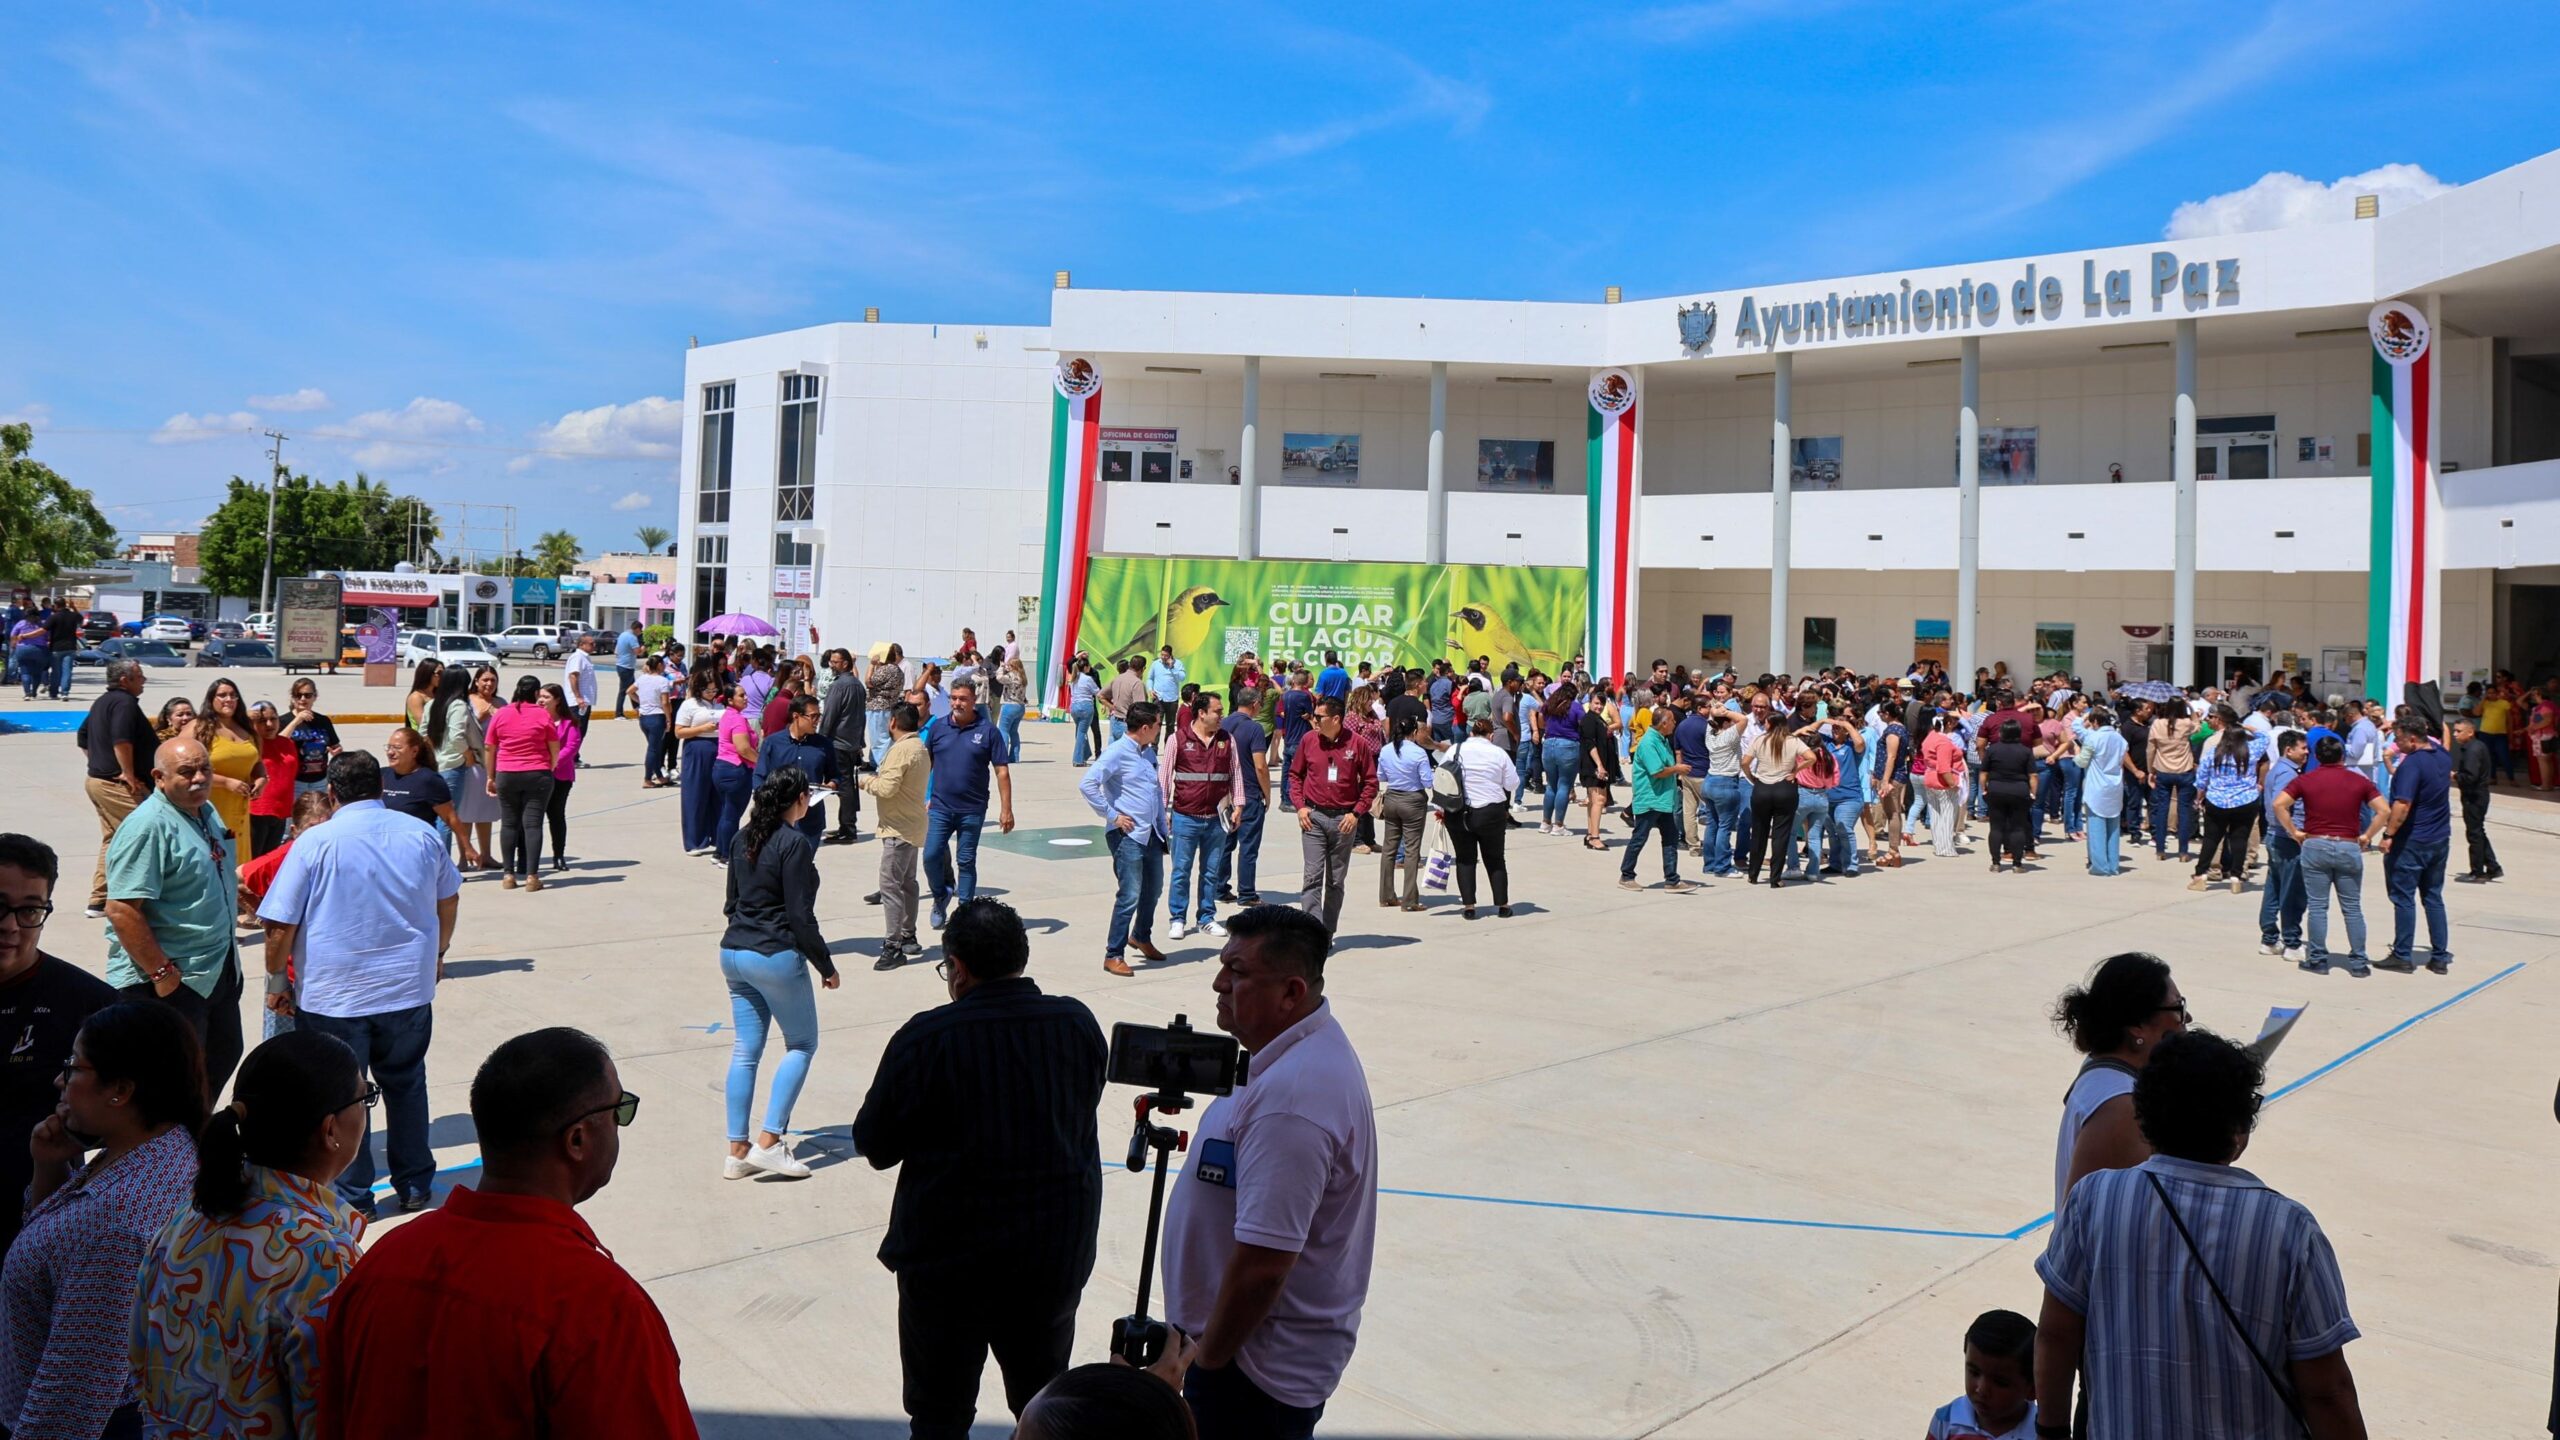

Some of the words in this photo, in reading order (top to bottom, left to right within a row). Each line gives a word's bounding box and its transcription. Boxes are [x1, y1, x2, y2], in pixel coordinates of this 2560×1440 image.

[1735, 278, 2000, 346] Ayuntamiento
[2011, 263, 2063, 312] de
[2083, 259, 2131, 305] La
[2151, 251, 2240, 300] Paz
[1102, 431, 1132, 439] OFICINA
[1144, 431, 1175, 440] GESTIÓN
[1269, 602, 1393, 626] CUIDAR
[1269, 626, 1302, 647] EL
[1310, 627, 1393, 648] AGUA
[2195, 629, 2249, 640] ESORERÍA
